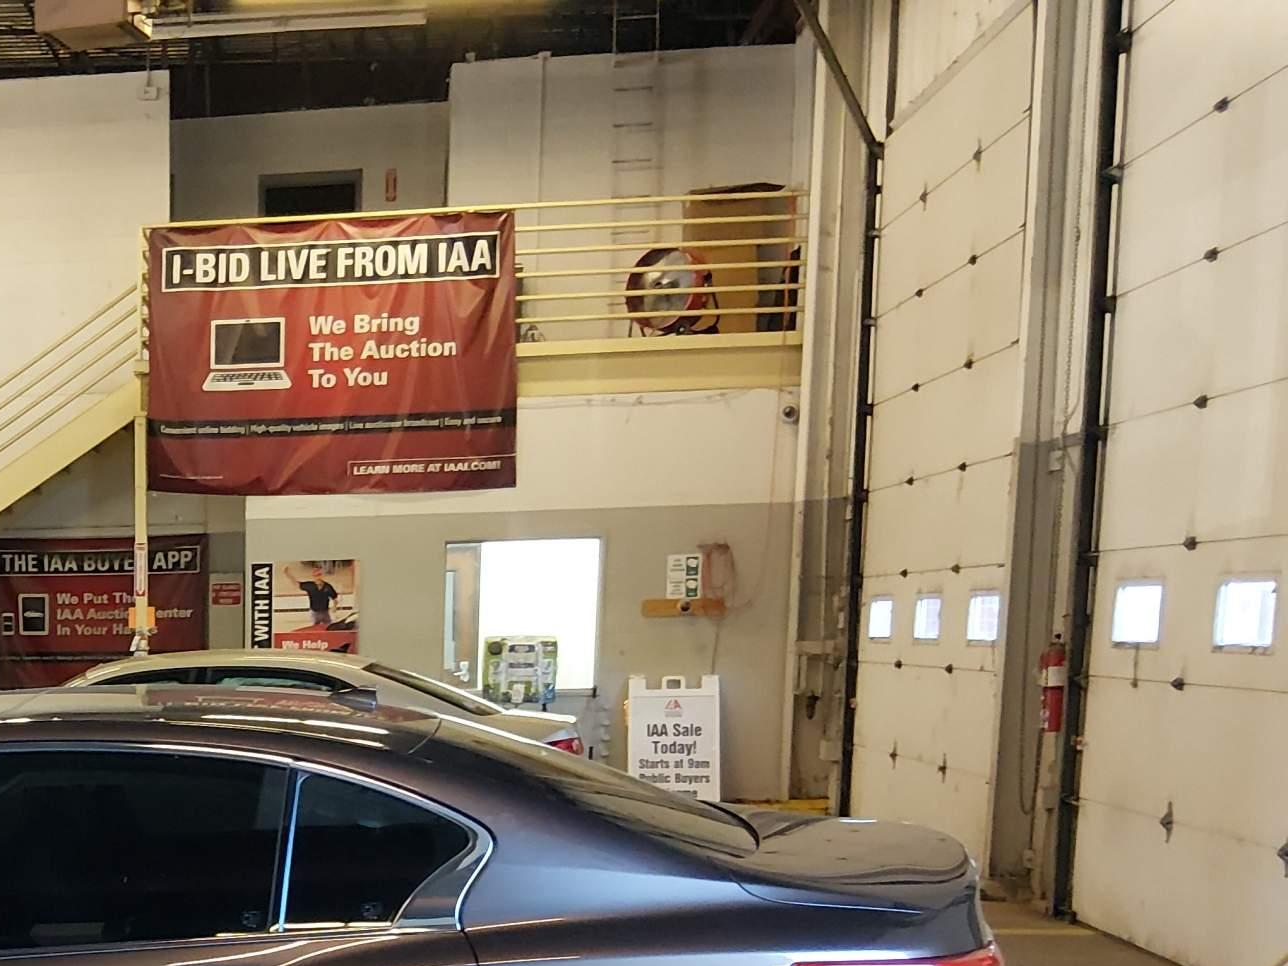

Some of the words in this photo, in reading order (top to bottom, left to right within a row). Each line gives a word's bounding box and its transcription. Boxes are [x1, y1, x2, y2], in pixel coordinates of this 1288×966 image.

[172, 252, 250, 284] I-BID
[260, 248, 330, 281] LIVE
[336, 243, 428, 278] FROM
[438, 239, 492, 274] IAA
[309, 315, 346, 335] We
[354, 313, 420, 335] Bring
[308, 342, 353, 362] The
[360, 340, 457, 360] Auction
[308, 369, 337, 389] To
[344, 367, 388, 386] You
[353, 465, 390, 475] LEARN
[392, 464, 424, 474] MORE
[427, 463, 441, 473] AT
[2, 554, 39, 572] THE
[43, 554, 78, 572] IAA
[83, 553, 135, 571] BUYE
[152, 551, 193, 570] APP
[254, 566, 270, 595] IAA
[56, 593, 79, 604] We
[83, 592, 108, 604] Put
[56, 608, 83, 620] IAA
[155, 608, 193, 619] enter
[254, 600, 270, 642] WITH
[56, 624, 70, 636] In
[75, 624, 107, 636] Your
[303, 640, 328, 650] Help
[647, 723, 668, 737] IAA
[673, 723, 702, 737] Sale
[652, 740, 697, 756] Today!
[638, 758, 670, 769] Starts
[673, 759, 684, 769] at
[687, 758, 710, 769] 9am
[674, 773, 710, 785] Buyers
